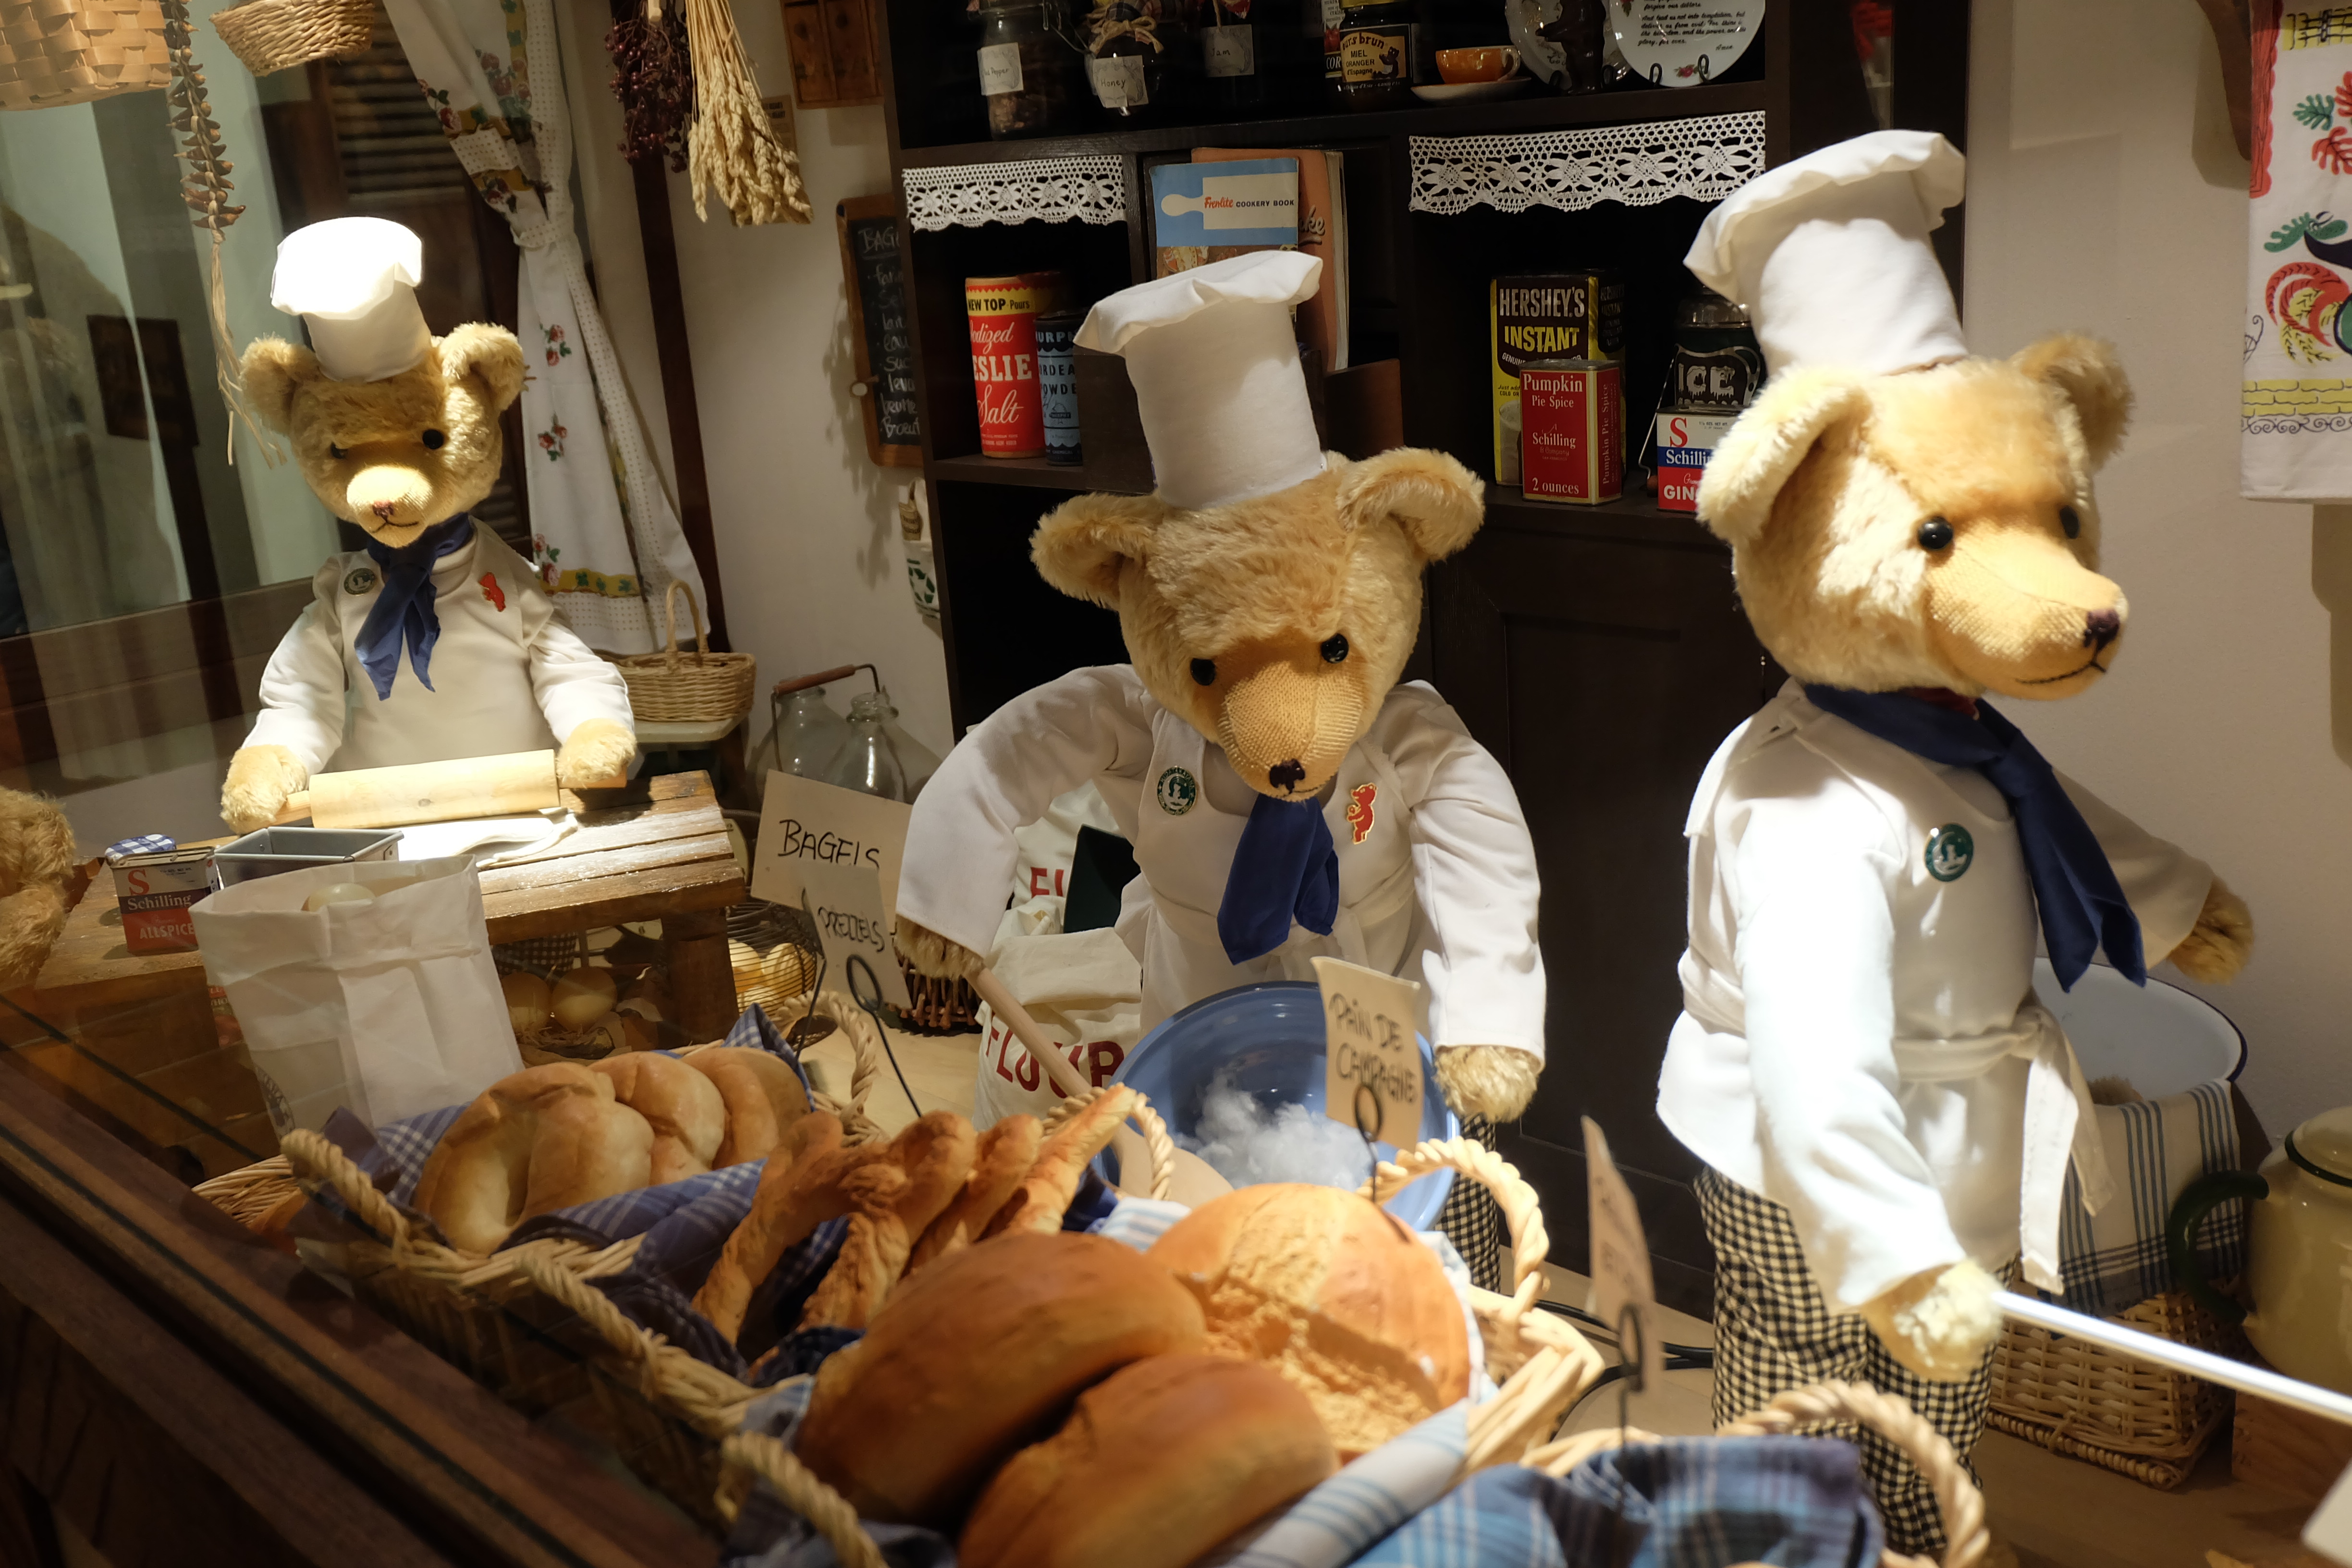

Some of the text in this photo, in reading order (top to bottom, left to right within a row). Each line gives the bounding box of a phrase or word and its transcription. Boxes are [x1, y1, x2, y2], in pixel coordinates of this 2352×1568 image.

[1343, 33, 1384, 50] ours brun
[1211, 48, 1230, 57] Jam
[1346, 59, 1374, 67] ORANGER
[1101, 78, 1126, 89] Honey
[1204, 196, 1233, 208] Frenlite
[984, 297, 1006, 311] TOP
[1010, 299, 1030, 310] Pours
[1499, 286, 1585, 318] HERSHEY'S
[1504, 325, 1580, 353] INSTANT
[1523, 373, 1583, 395] Pumpkin
[1678, 363, 1735, 401] ICE
[977, 384, 1024, 428] Salt
[1532, 395, 1574, 410] Pie Spice
[1532, 432, 1576, 449] Schilling
[1670, 417, 1688, 448] S
[1545, 447, 1569, 456] Company
[1532, 477, 1579, 494] 2 ounces
[1664, 485, 1698, 501] GIN
[128, 868, 149, 896] S
[127, 895, 191, 910] Schilling
[139, 922, 195, 940] ALLSPICE
[1374, 1013, 1404, 1053] DE
